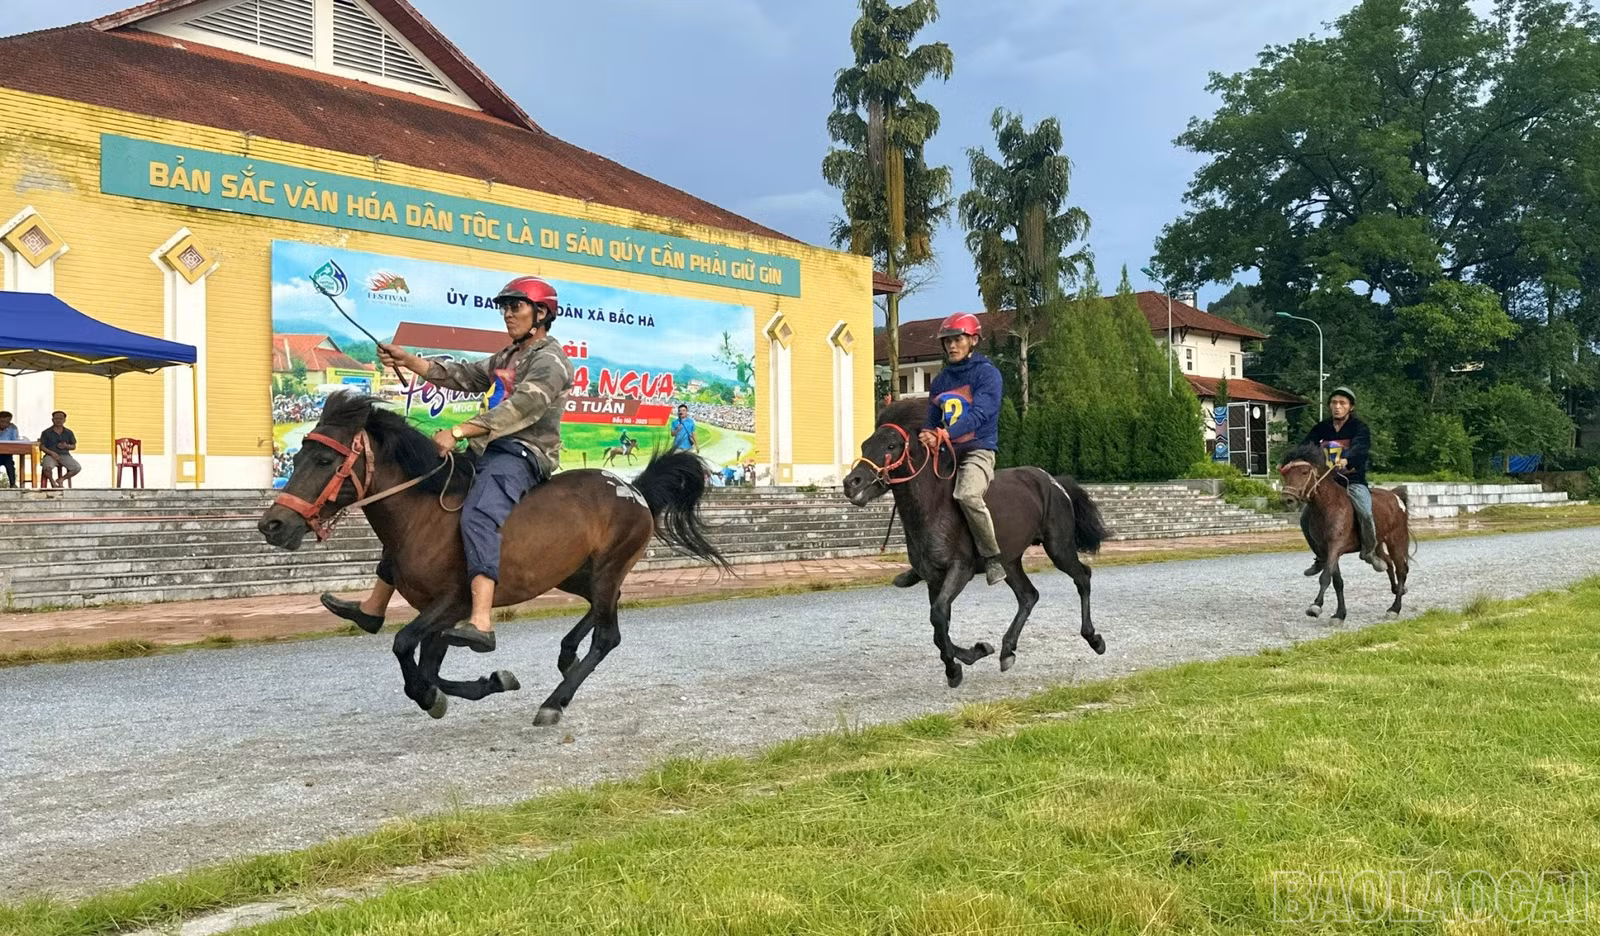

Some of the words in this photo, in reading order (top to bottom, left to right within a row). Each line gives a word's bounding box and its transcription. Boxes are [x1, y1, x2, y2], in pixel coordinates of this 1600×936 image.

[149, 155, 211, 194] BẢN
[220, 163, 276, 204] SẮC
[283, 179, 339, 213] VĂN
[346, 191, 398, 223] HÓA
[405, 201, 453, 232] DÂN
[459, 211, 500, 243] TỘC
[506, 218, 534, 246] LÀ
[540, 228, 560, 250] DI
[566, 227, 604, 257] SẢN
[609, 236, 646, 263] QÚY
[651, 241, 685, 270] CẦN
[690, 250, 727, 276] PHẢI
[731, 258, 755, 281] GIỮ
[759, 261, 782, 285] GÌN
[446, 288, 468, 306] ỦY
[588, 307, 605, 321] XÃ
[609, 308, 634, 325] BẮC
[638, 313, 655, 327] HÀ
